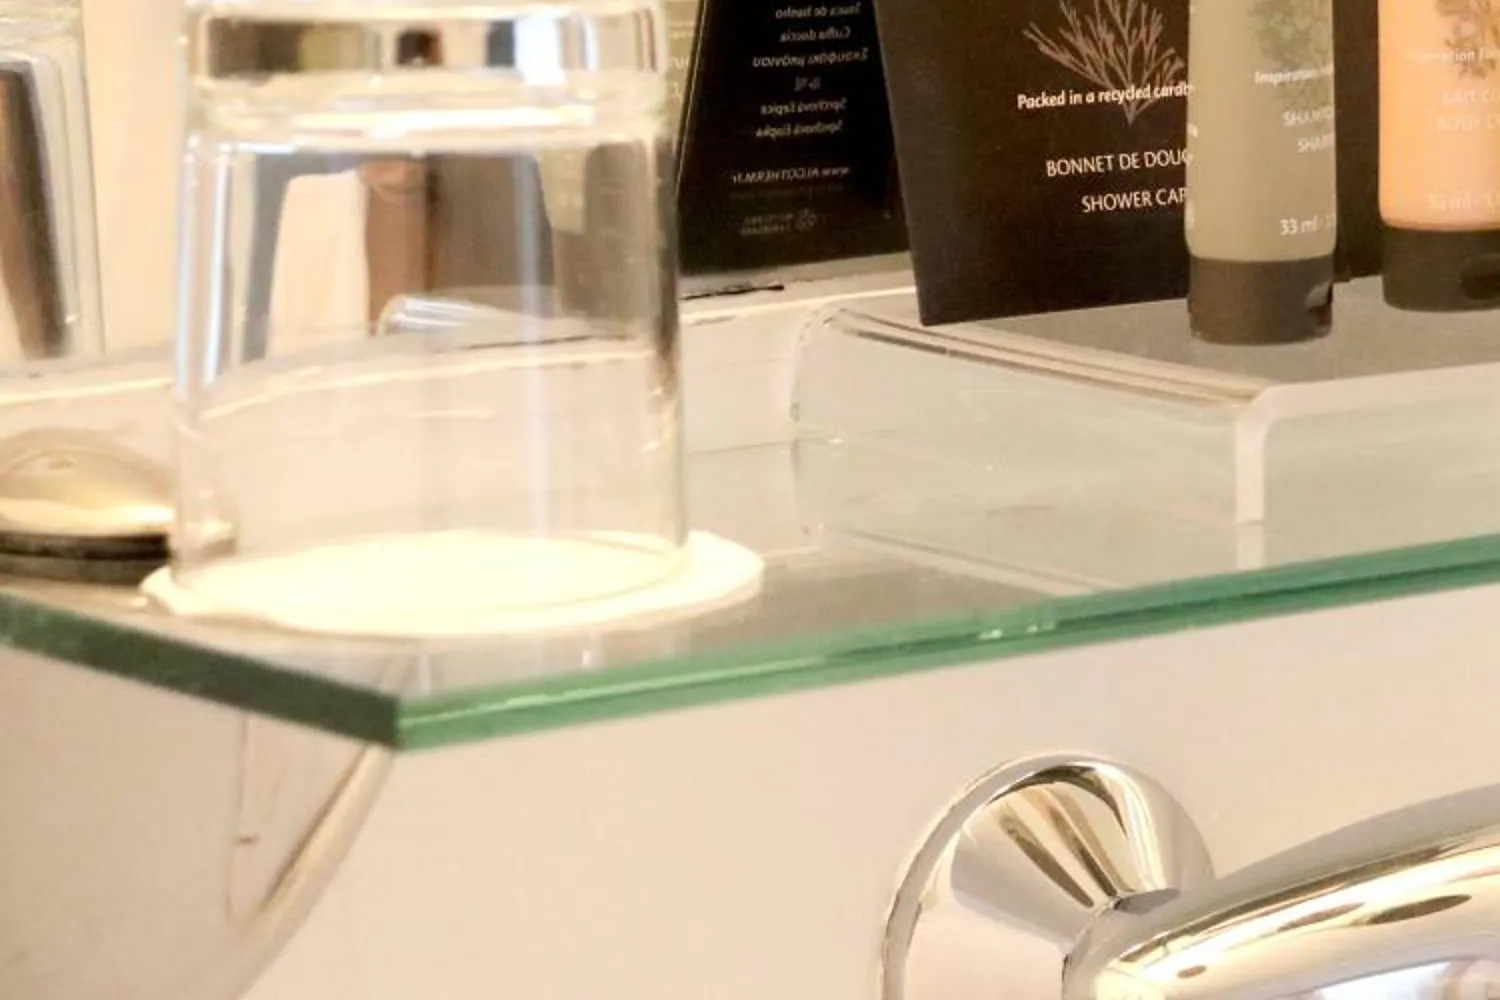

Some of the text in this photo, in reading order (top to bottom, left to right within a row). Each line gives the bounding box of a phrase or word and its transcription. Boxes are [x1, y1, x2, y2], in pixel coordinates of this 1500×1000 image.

[1017, 90, 1065, 111] Packed
[1069, 89, 1082, 105] in
[1086, 92, 1096, 104] a
[1098, 84, 1151, 105] recycled
[1045, 154, 1115, 178] BONNET
[1119, 151, 1141, 170] DE
[1080, 190, 1152, 213] SHOWER
[1279, 215, 1299, 236] 33
